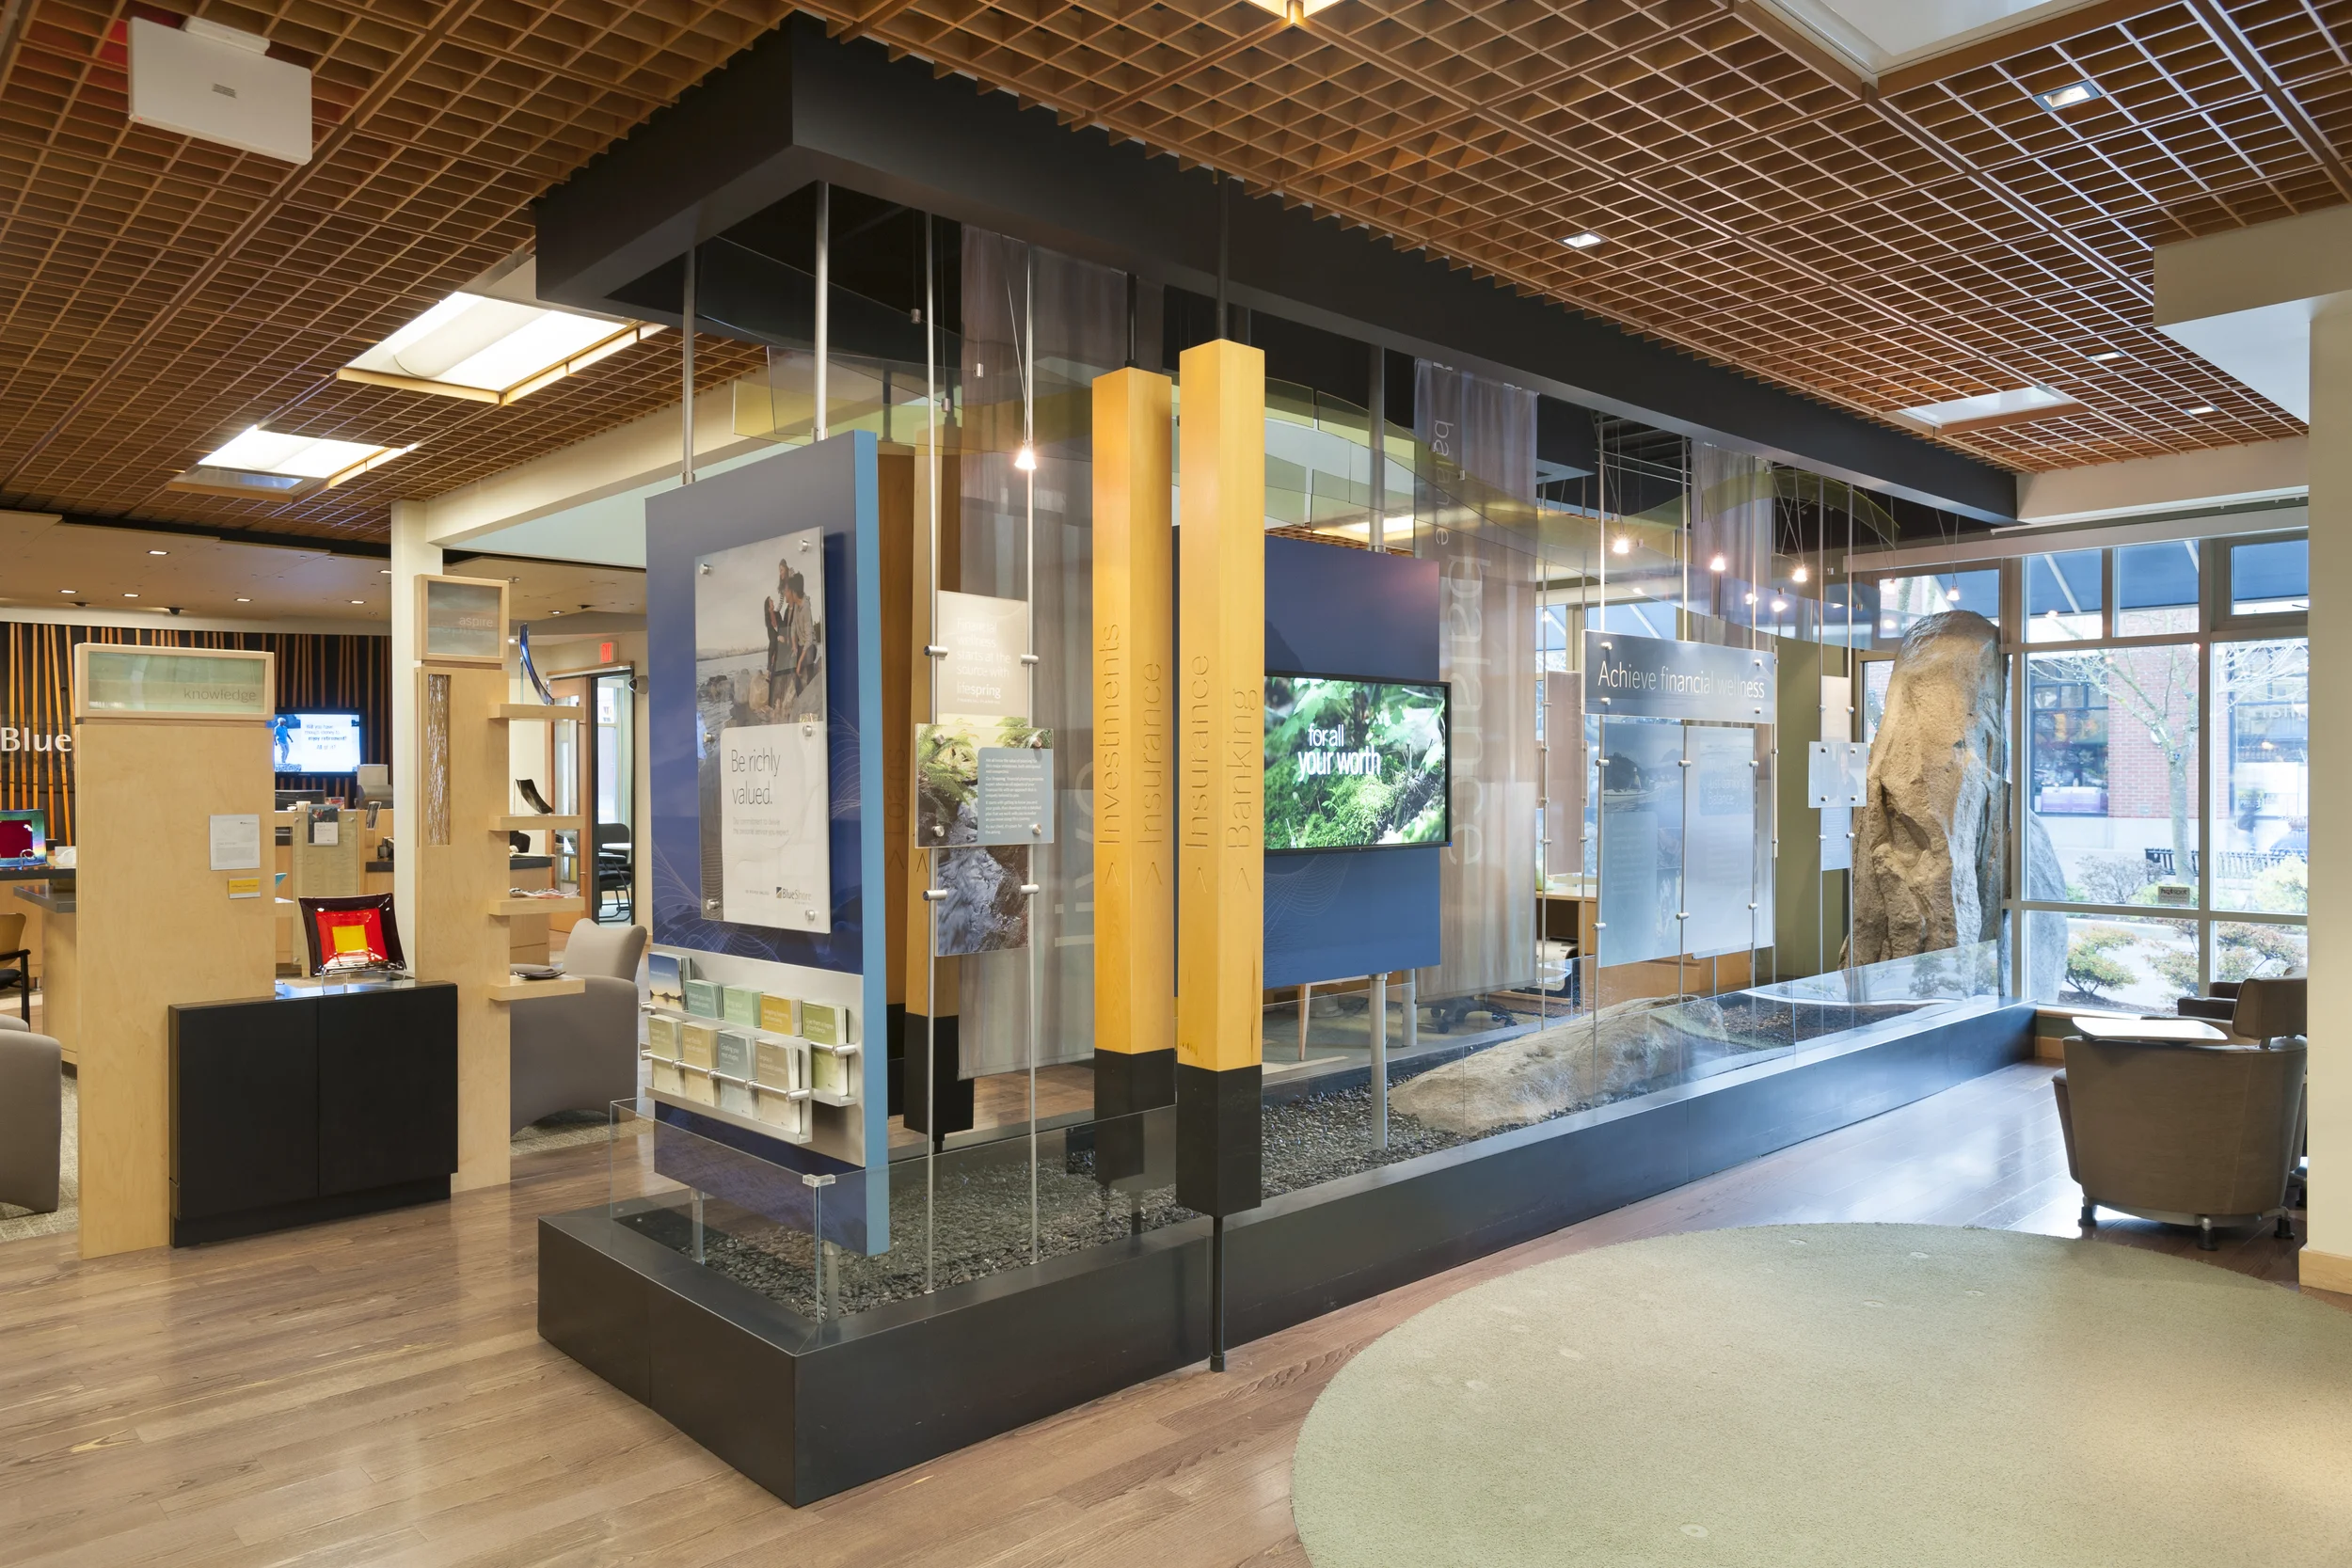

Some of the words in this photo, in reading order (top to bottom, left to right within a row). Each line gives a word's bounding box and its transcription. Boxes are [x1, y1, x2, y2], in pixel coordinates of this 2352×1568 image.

[459, 617, 493, 627] aspire
[957, 633, 997, 649] wellness
[957, 651, 984, 662] starts
[996, 652, 1011, 664] the
[957, 665, 988, 677] source
[990, 667, 1009, 678] with
[1597, 660, 1657, 690] Achieve
[1661, 665, 1714, 694] financial
[1717, 672, 1765, 699] wellness
[183, 688, 257, 704] knowledge
[957, 681, 1001, 700] lifespring
[1446, 555, 1491, 866] balance
[1, 727, 72, 752] Blue
[1099, 623, 1120, 846] Investments
[1308, 723, 1328, 747] for
[1328, 723, 1344, 747] all
[731, 749, 745, 772] Be
[749, 747, 781, 777] richly
[1137, 661, 1162, 844] Insurance
[1184, 655, 1210, 849] Insurance
[1297, 751, 1334, 782] your
[1336, 745, 1381, 775] worth
[1226, 688, 1258, 849] Banking
[732, 780, 772, 805] valued.
[886, 749, 905, 835] Loans
[783, 888, 812, 900] BlueShore
